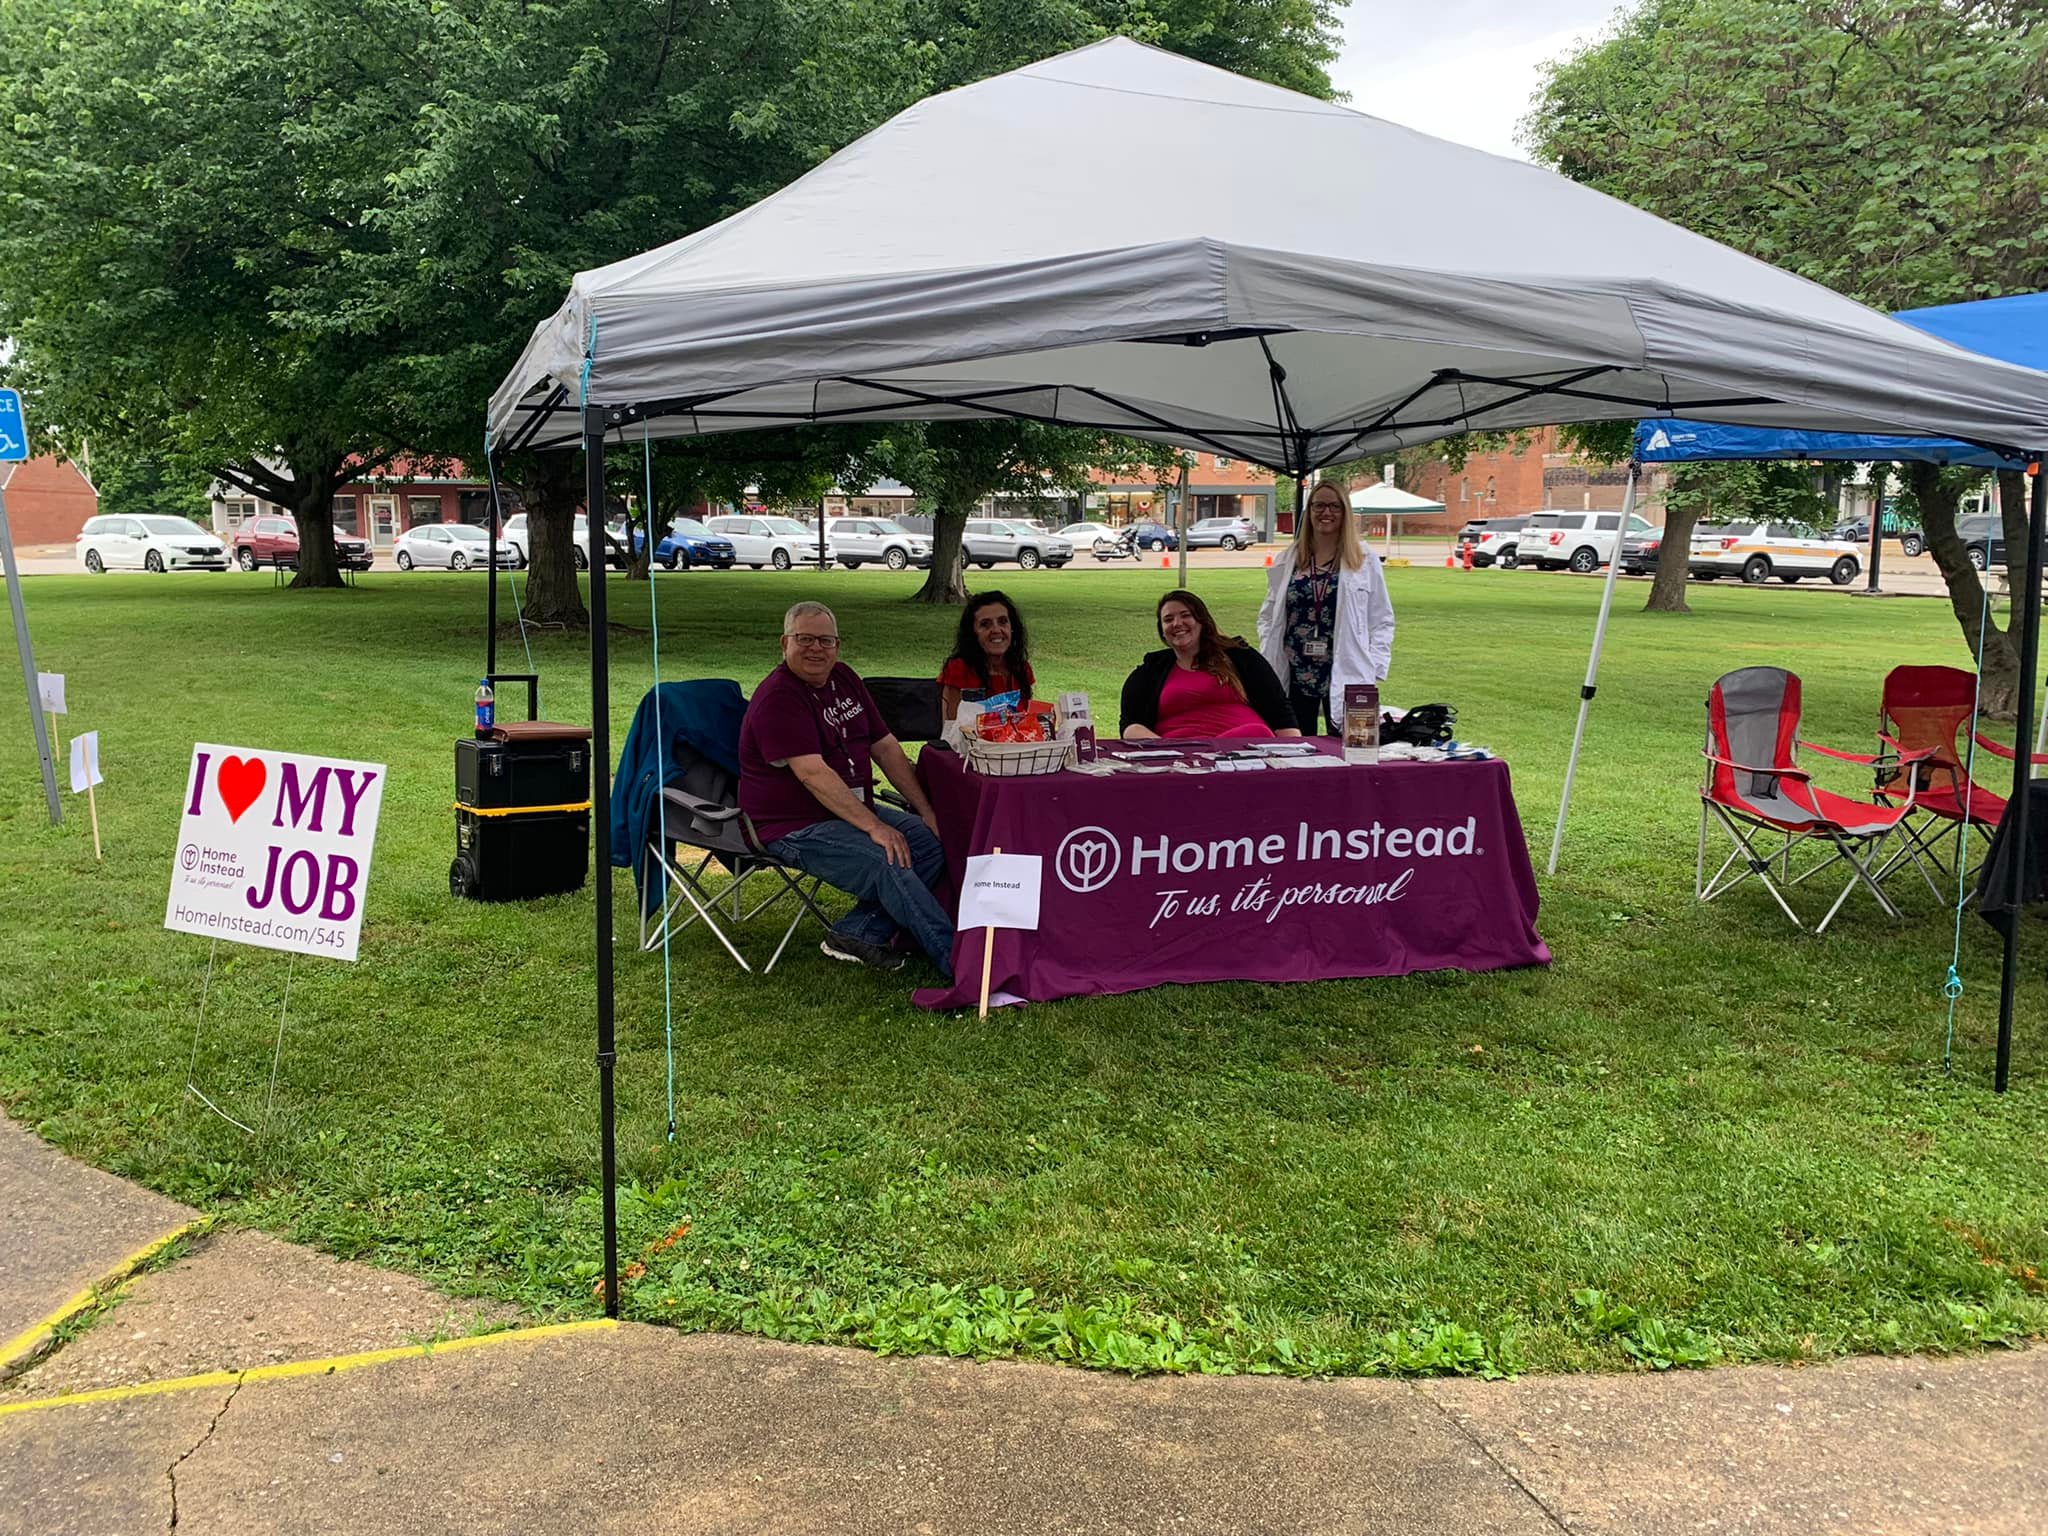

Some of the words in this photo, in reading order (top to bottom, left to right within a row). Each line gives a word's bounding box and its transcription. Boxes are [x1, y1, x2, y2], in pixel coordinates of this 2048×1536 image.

[187, 752, 211, 816] I
[272, 762, 378, 836] MY
[199, 860, 245, 878] Instead
[202, 846, 237, 863] Home
[1130, 834, 1286, 876] Home
[1296, 816, 1477, 861] Instead
[246, 845, 359, 922] JOB
[993, 881, 1021, 889] Instead
[1149, 889, 1189, 929] To
[1185, 894, 1222, 917] us,
[1230, 873, 1275, 911] it's
[1266, 868, 1415, 924] personal
[175, 904, 346, 949] HomeInstead.com/545
